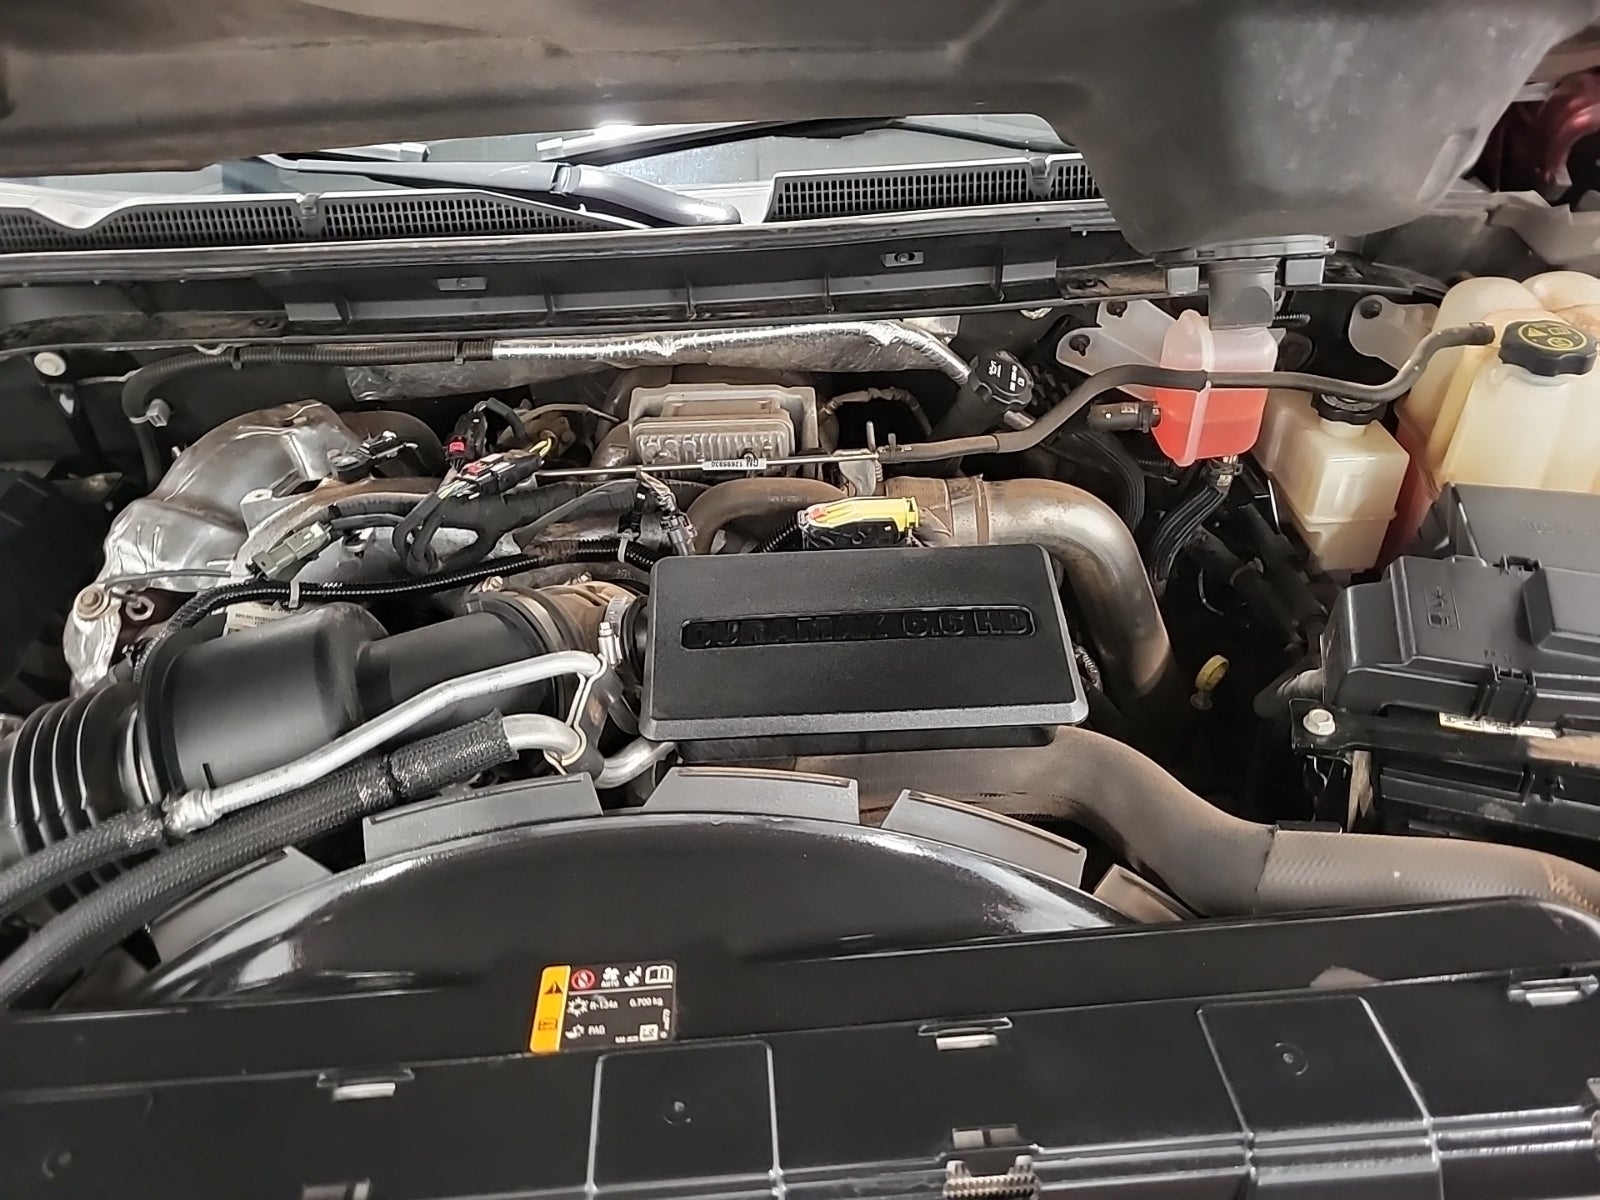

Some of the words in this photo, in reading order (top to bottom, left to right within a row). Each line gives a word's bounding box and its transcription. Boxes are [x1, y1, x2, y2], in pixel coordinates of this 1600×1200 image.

[746, 457, 759, 468] GM
[903, 611, 966, 638] 6.6
[975, 609, 1029, 636] HD
